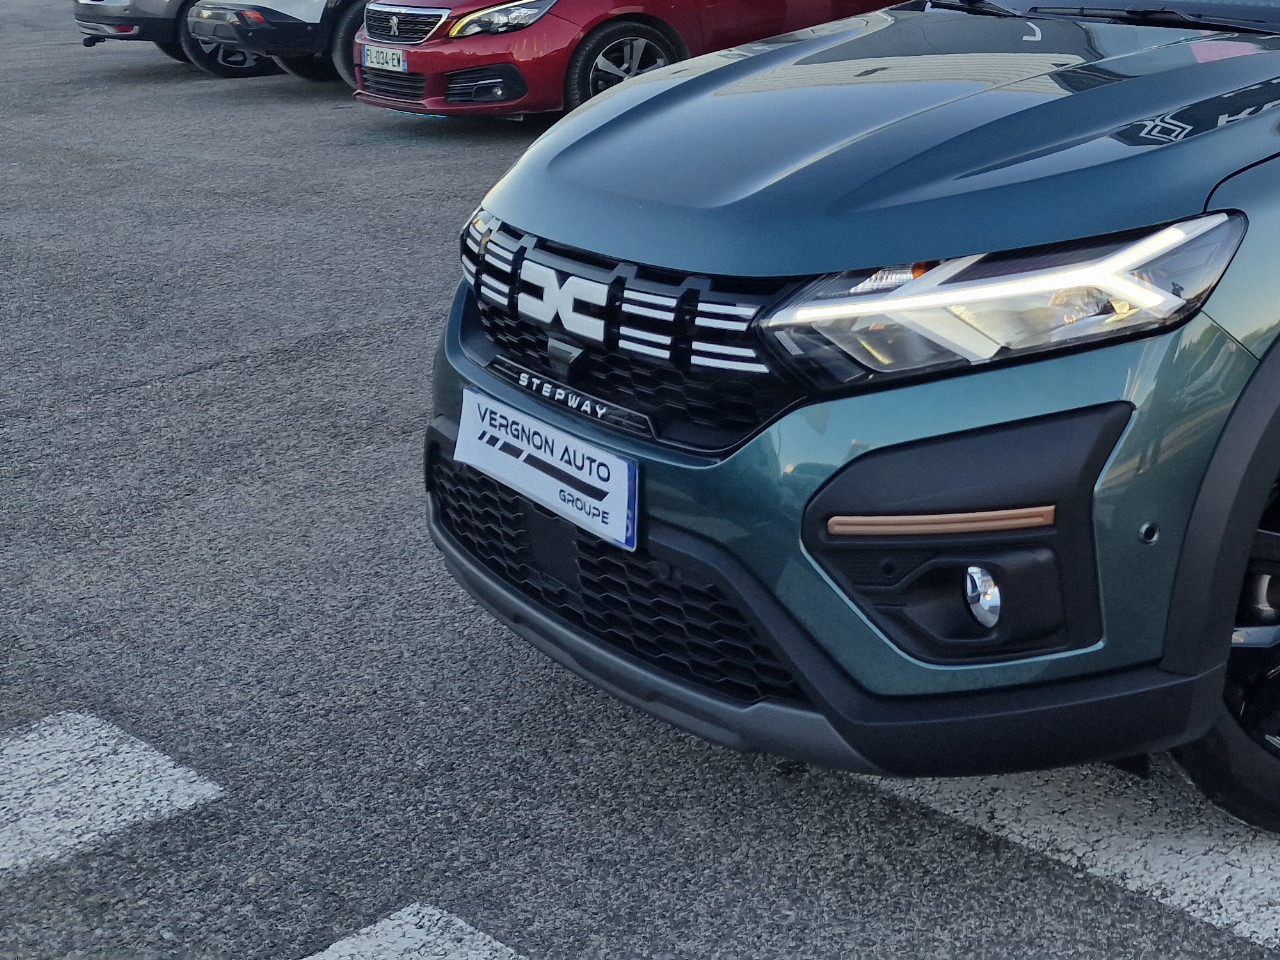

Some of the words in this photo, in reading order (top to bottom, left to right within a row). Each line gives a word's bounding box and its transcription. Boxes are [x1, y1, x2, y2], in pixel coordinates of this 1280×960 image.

[518, 372, 607, 419] STEPWAY
[477, 402, 555, 458] VERGNON
[559, 444, 611, 483] AUTO
[558, 488, 610, 526] GROUPE
